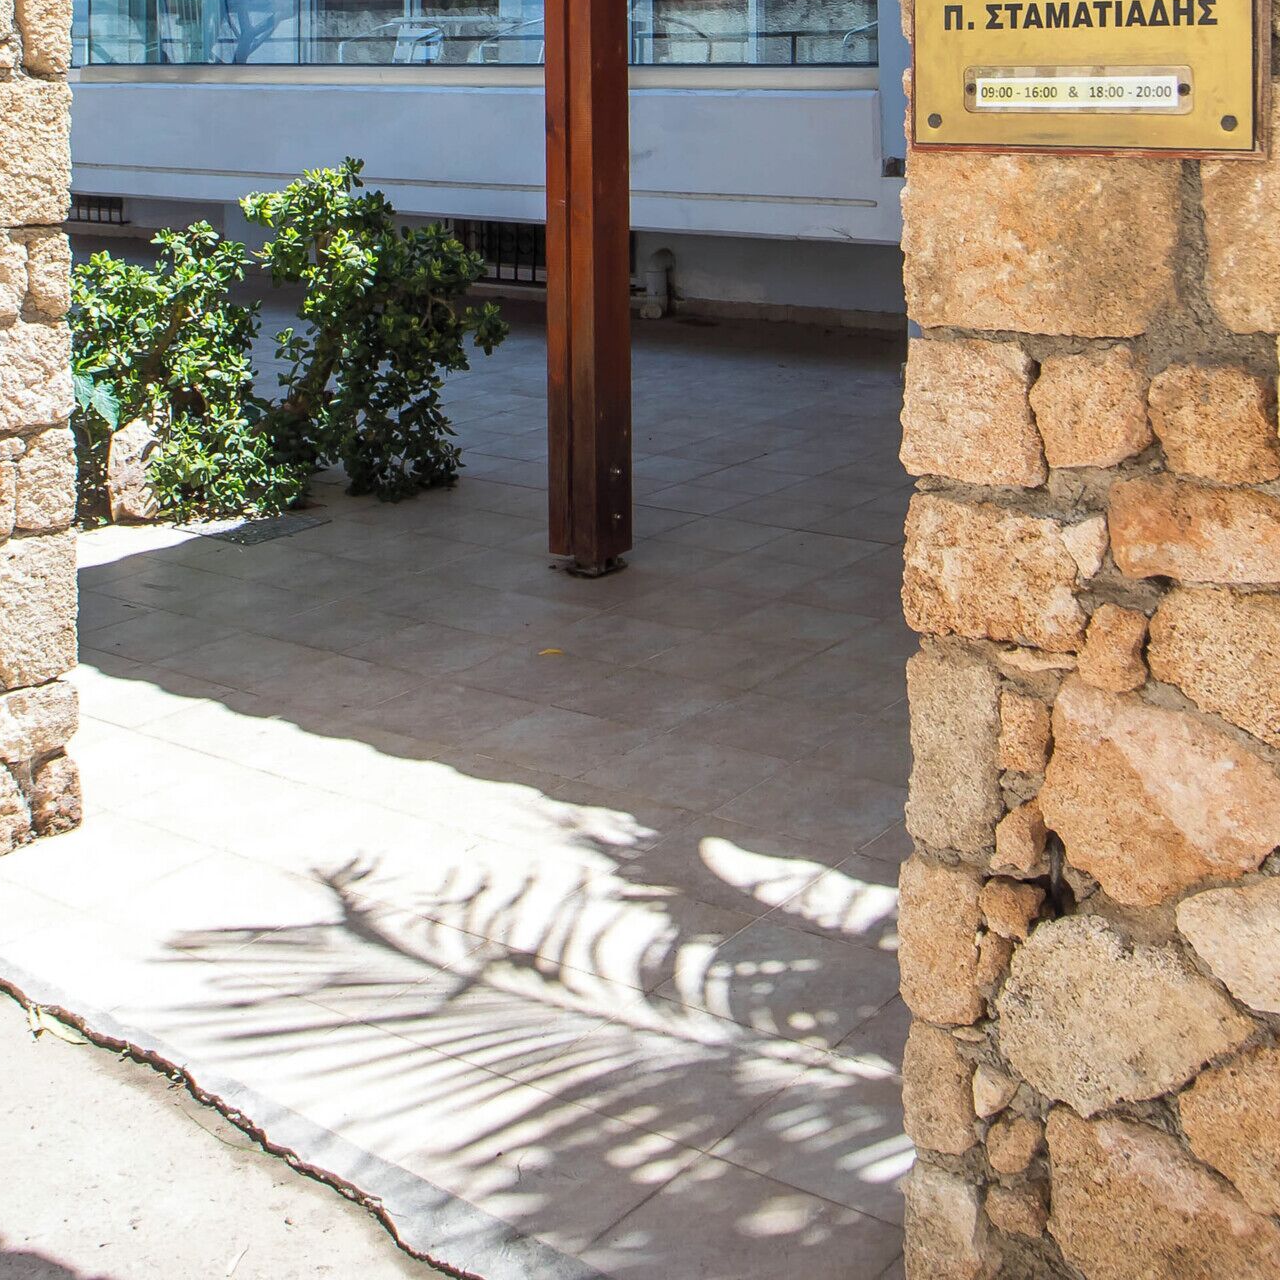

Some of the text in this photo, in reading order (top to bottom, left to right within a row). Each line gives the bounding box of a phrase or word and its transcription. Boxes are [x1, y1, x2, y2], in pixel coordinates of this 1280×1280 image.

[944, 4, 975, 31] Π.
[980, 86, 1013, 98] 09:00
[1024, 86, 1058, 98] 16:00
[1068, 85, 1079, 98] &
[1089, 85, 1125, 98] 18:00
[1135, 84, 1172, 98] 20:00
